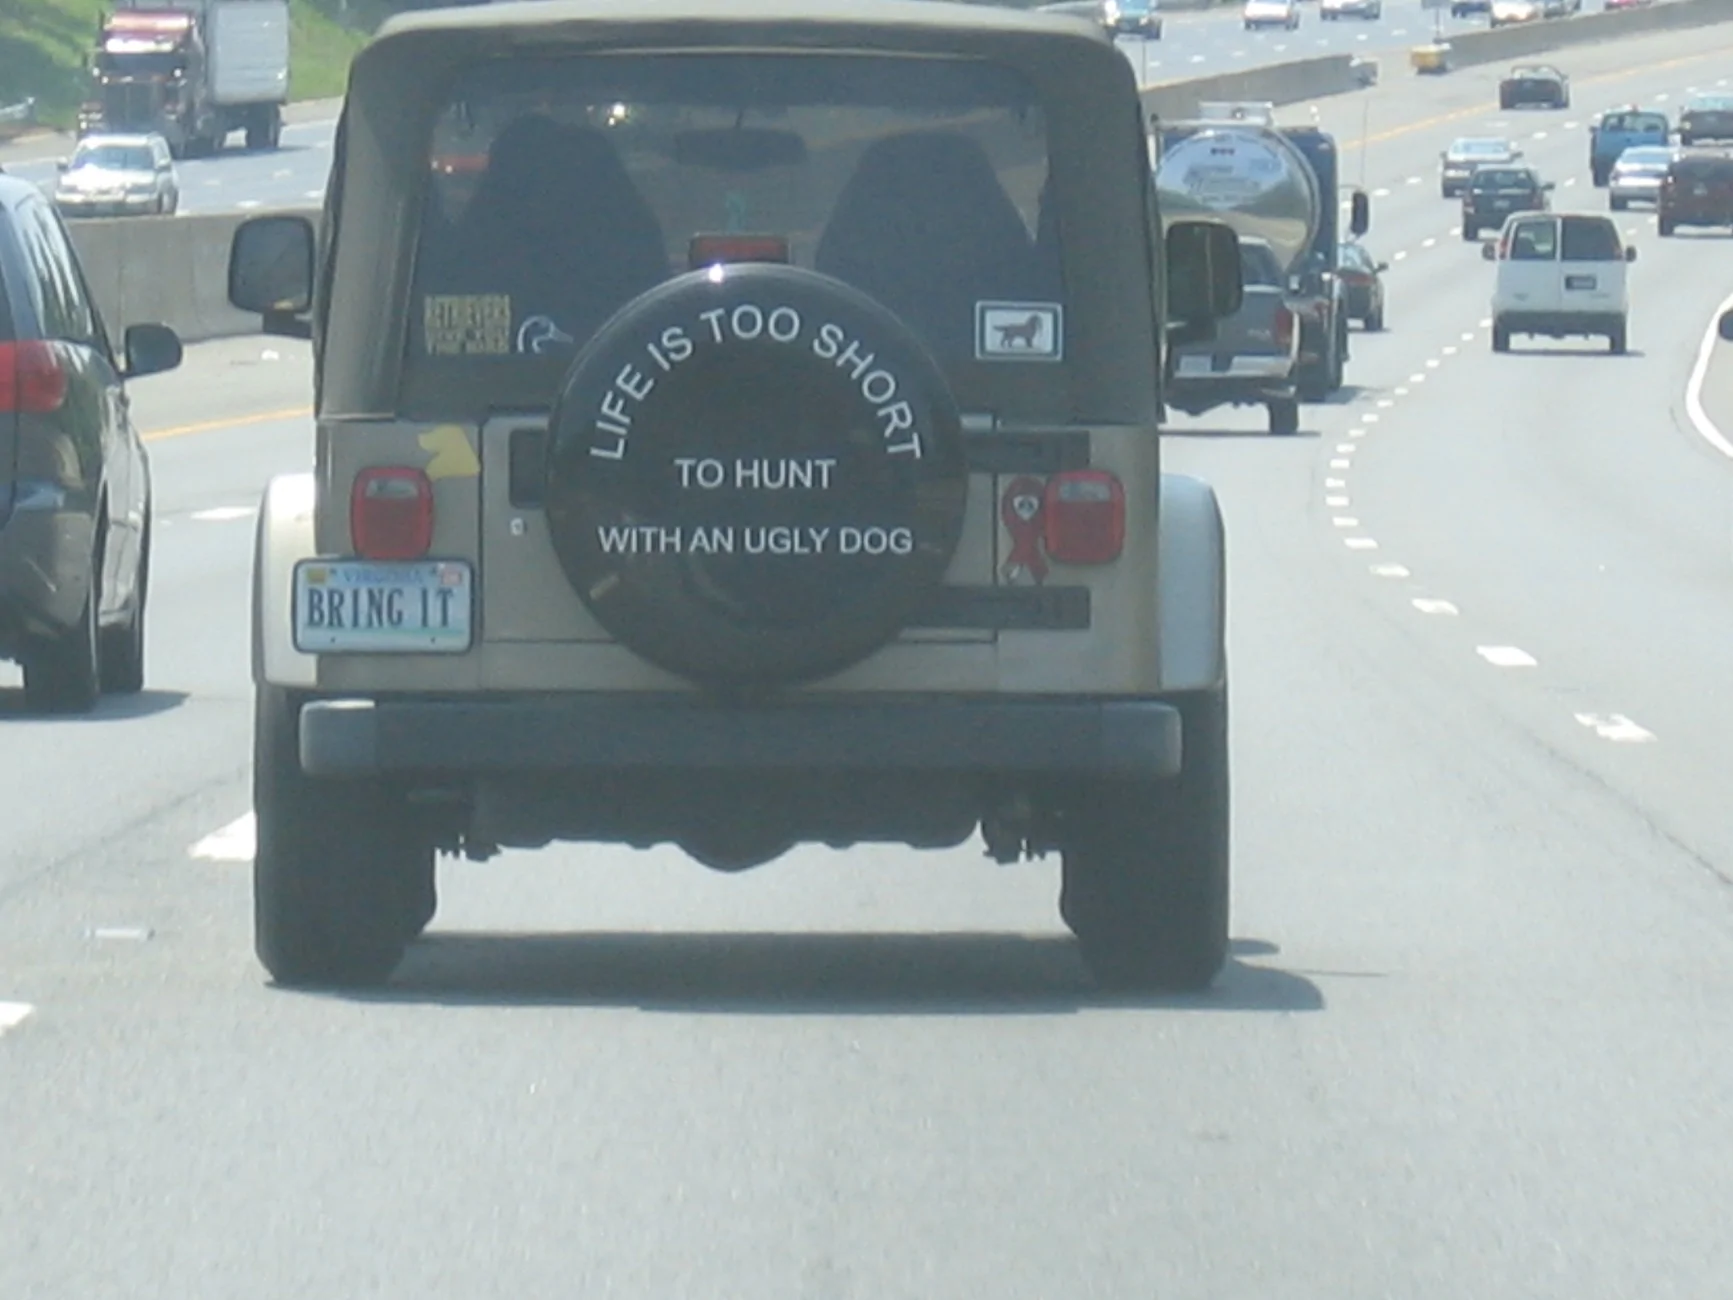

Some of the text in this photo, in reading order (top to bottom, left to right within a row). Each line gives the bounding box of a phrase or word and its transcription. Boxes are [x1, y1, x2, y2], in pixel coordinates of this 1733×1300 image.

[590, 304, 921, 460] LIFE IS TOO SHORT
[675, 459, 836, 489] TO HUNT
[598, 526, 913, 554] WITH AN UGLY DOG
[307, 587, 405, 629] BRING
